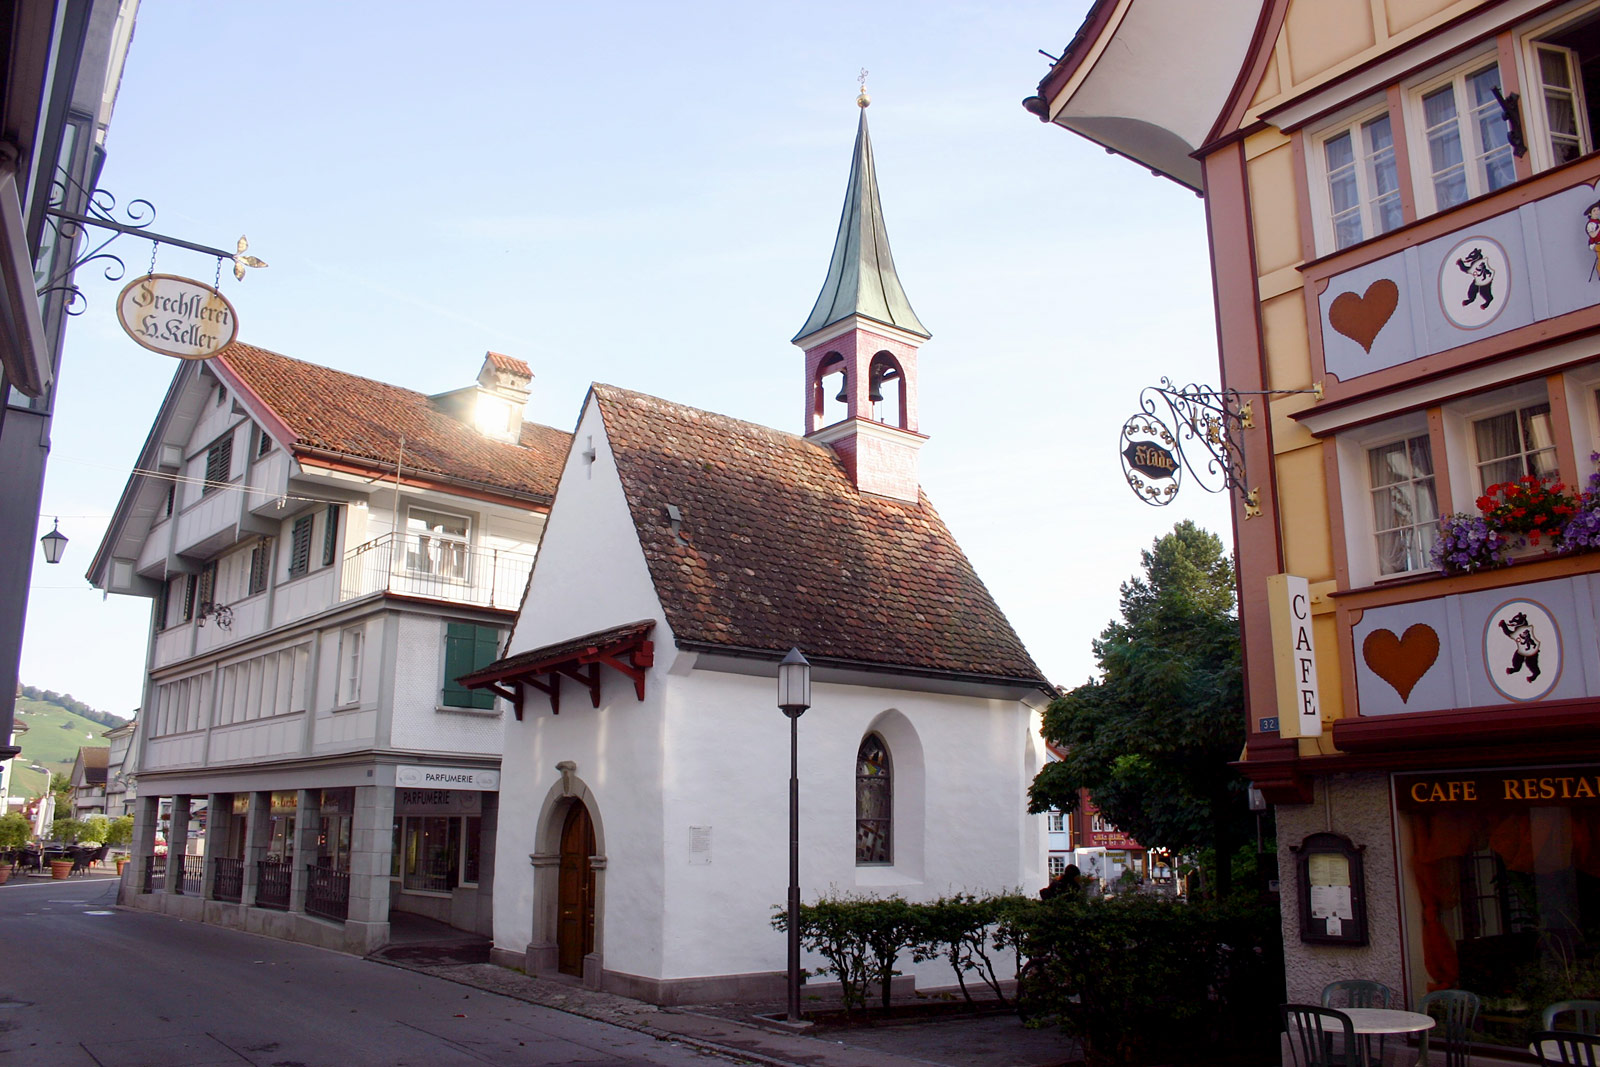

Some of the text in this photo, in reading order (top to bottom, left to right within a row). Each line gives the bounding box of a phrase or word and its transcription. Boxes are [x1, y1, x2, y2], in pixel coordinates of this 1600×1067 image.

[1135, 445, 1175, 472] Flade
[1292, 594, 1316, 715] CAFE
[1263, 720, 1275, 729] 32
[425, 773, 473, 783] PARFUMERIE
[402, 791, 450, 805] PARFUMERIE
[1411, 776, 1600, 802] CAFE RESTA
